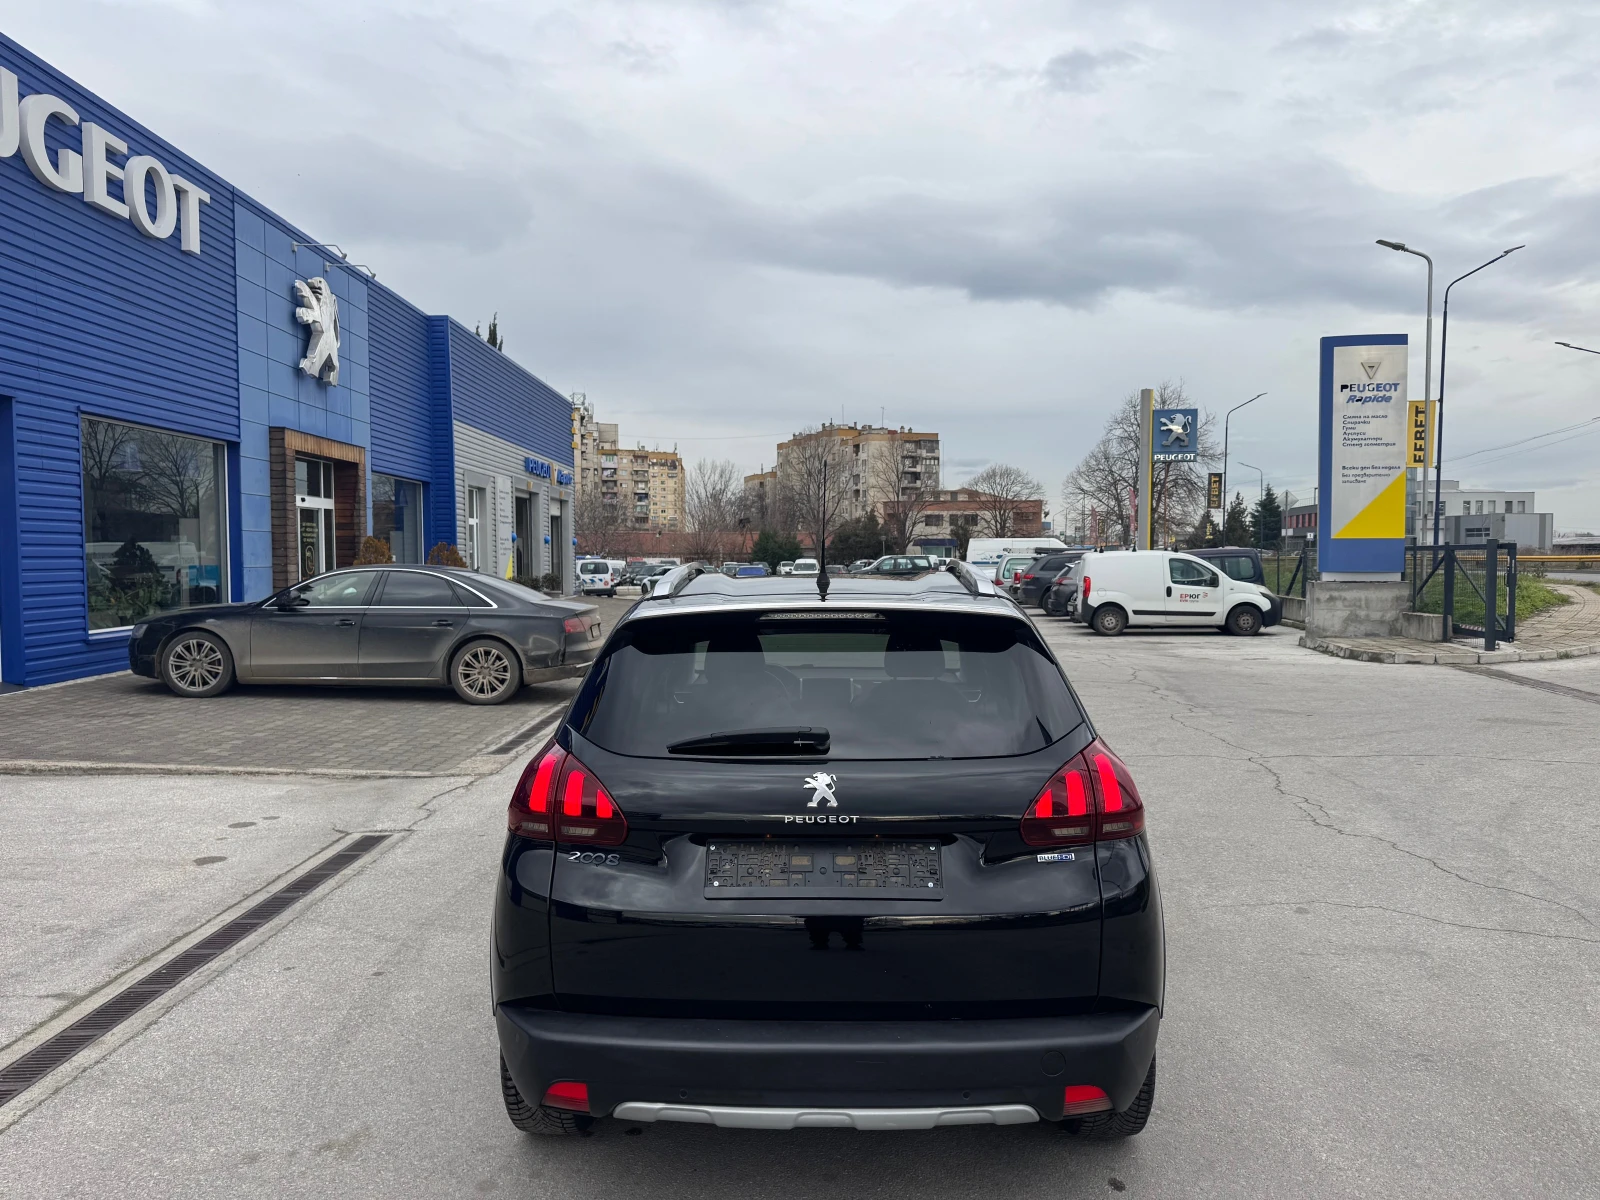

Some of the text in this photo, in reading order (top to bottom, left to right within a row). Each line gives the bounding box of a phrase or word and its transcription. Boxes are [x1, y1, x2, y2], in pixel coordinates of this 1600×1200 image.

[1340, 382, 1400, 393] PEUGEOT
[1346, 393, 1393, 405] Rapide
[1154, 453, 1196, 461] PEUGEOT
[784, 815, 860, 823] PEUGEOT
[567, 851, 620, 866] 2008
